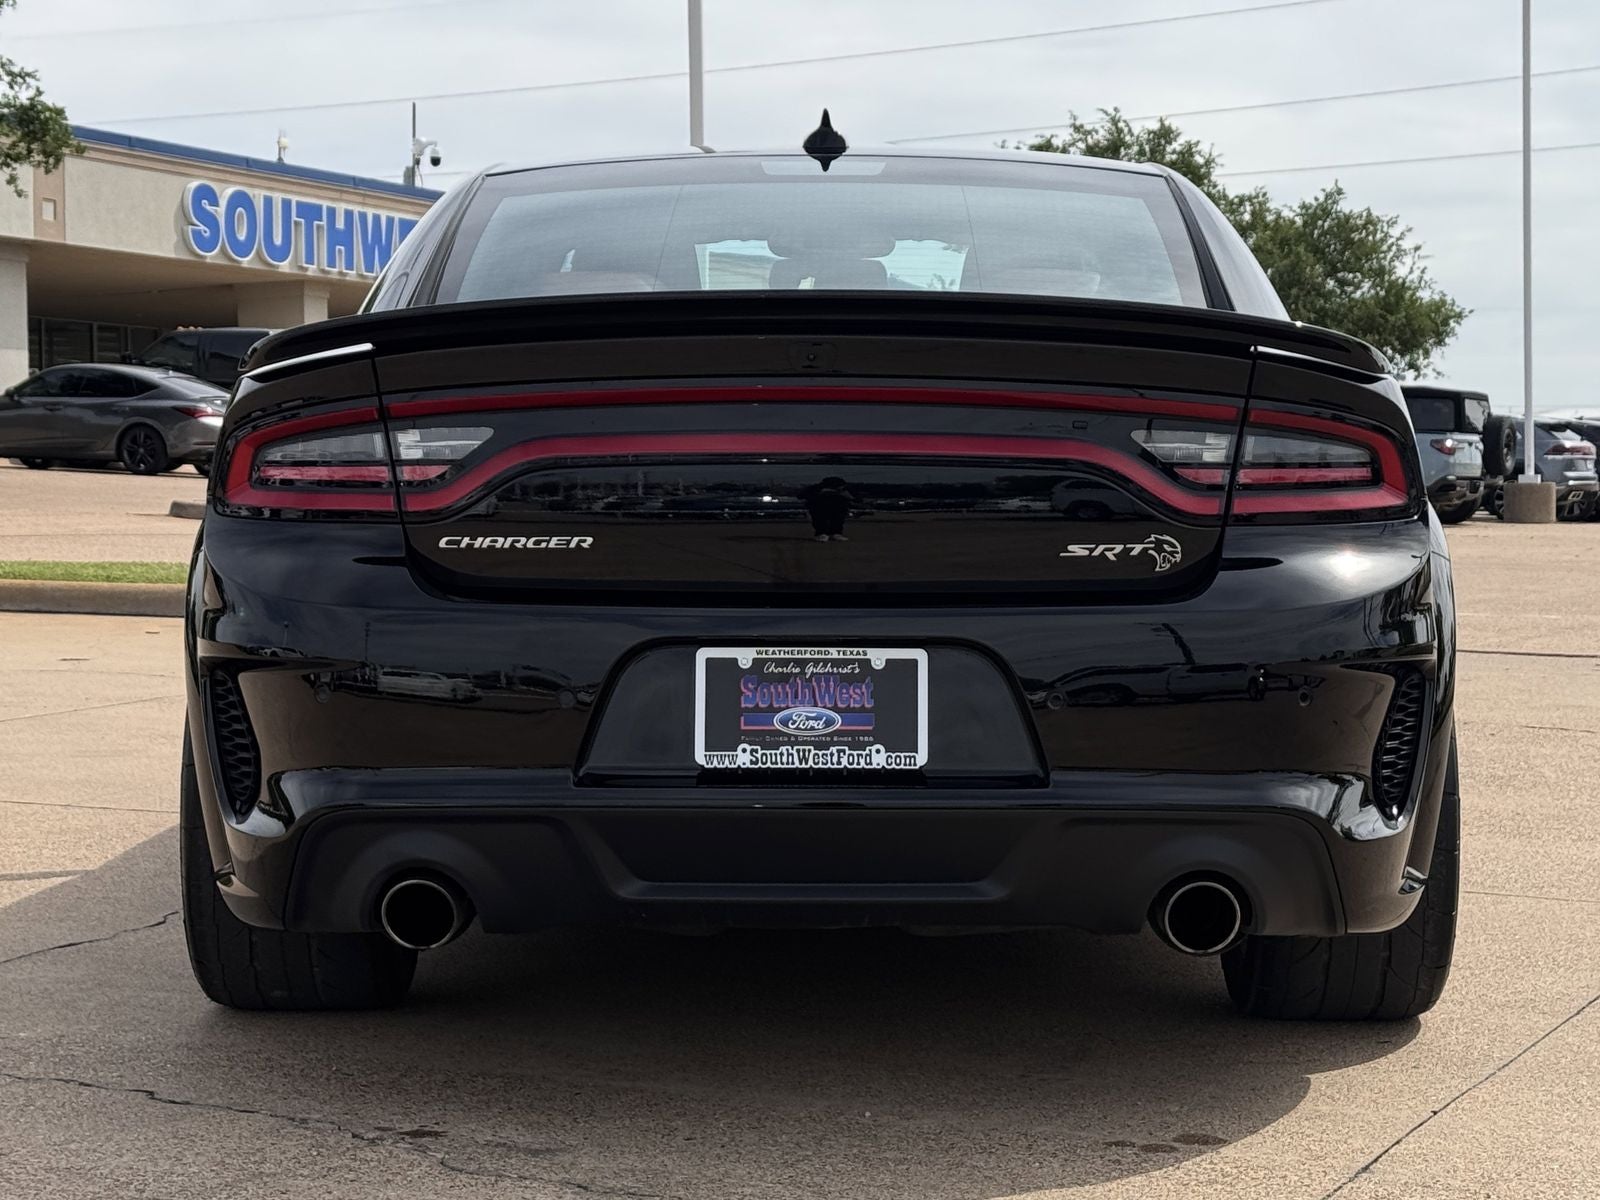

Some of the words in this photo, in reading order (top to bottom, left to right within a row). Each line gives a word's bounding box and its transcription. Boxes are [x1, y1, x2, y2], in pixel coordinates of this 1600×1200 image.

[438, 536, 594, 548] CHARGER
[1059, 543, 1155, 561] SRT
[763, 661, 801, 673] Charlie
[805, 661, 860, 678] Gilchrist's
[740, 674, 874, 708] SouthWest
[788, 711, 826, 729] Ford
